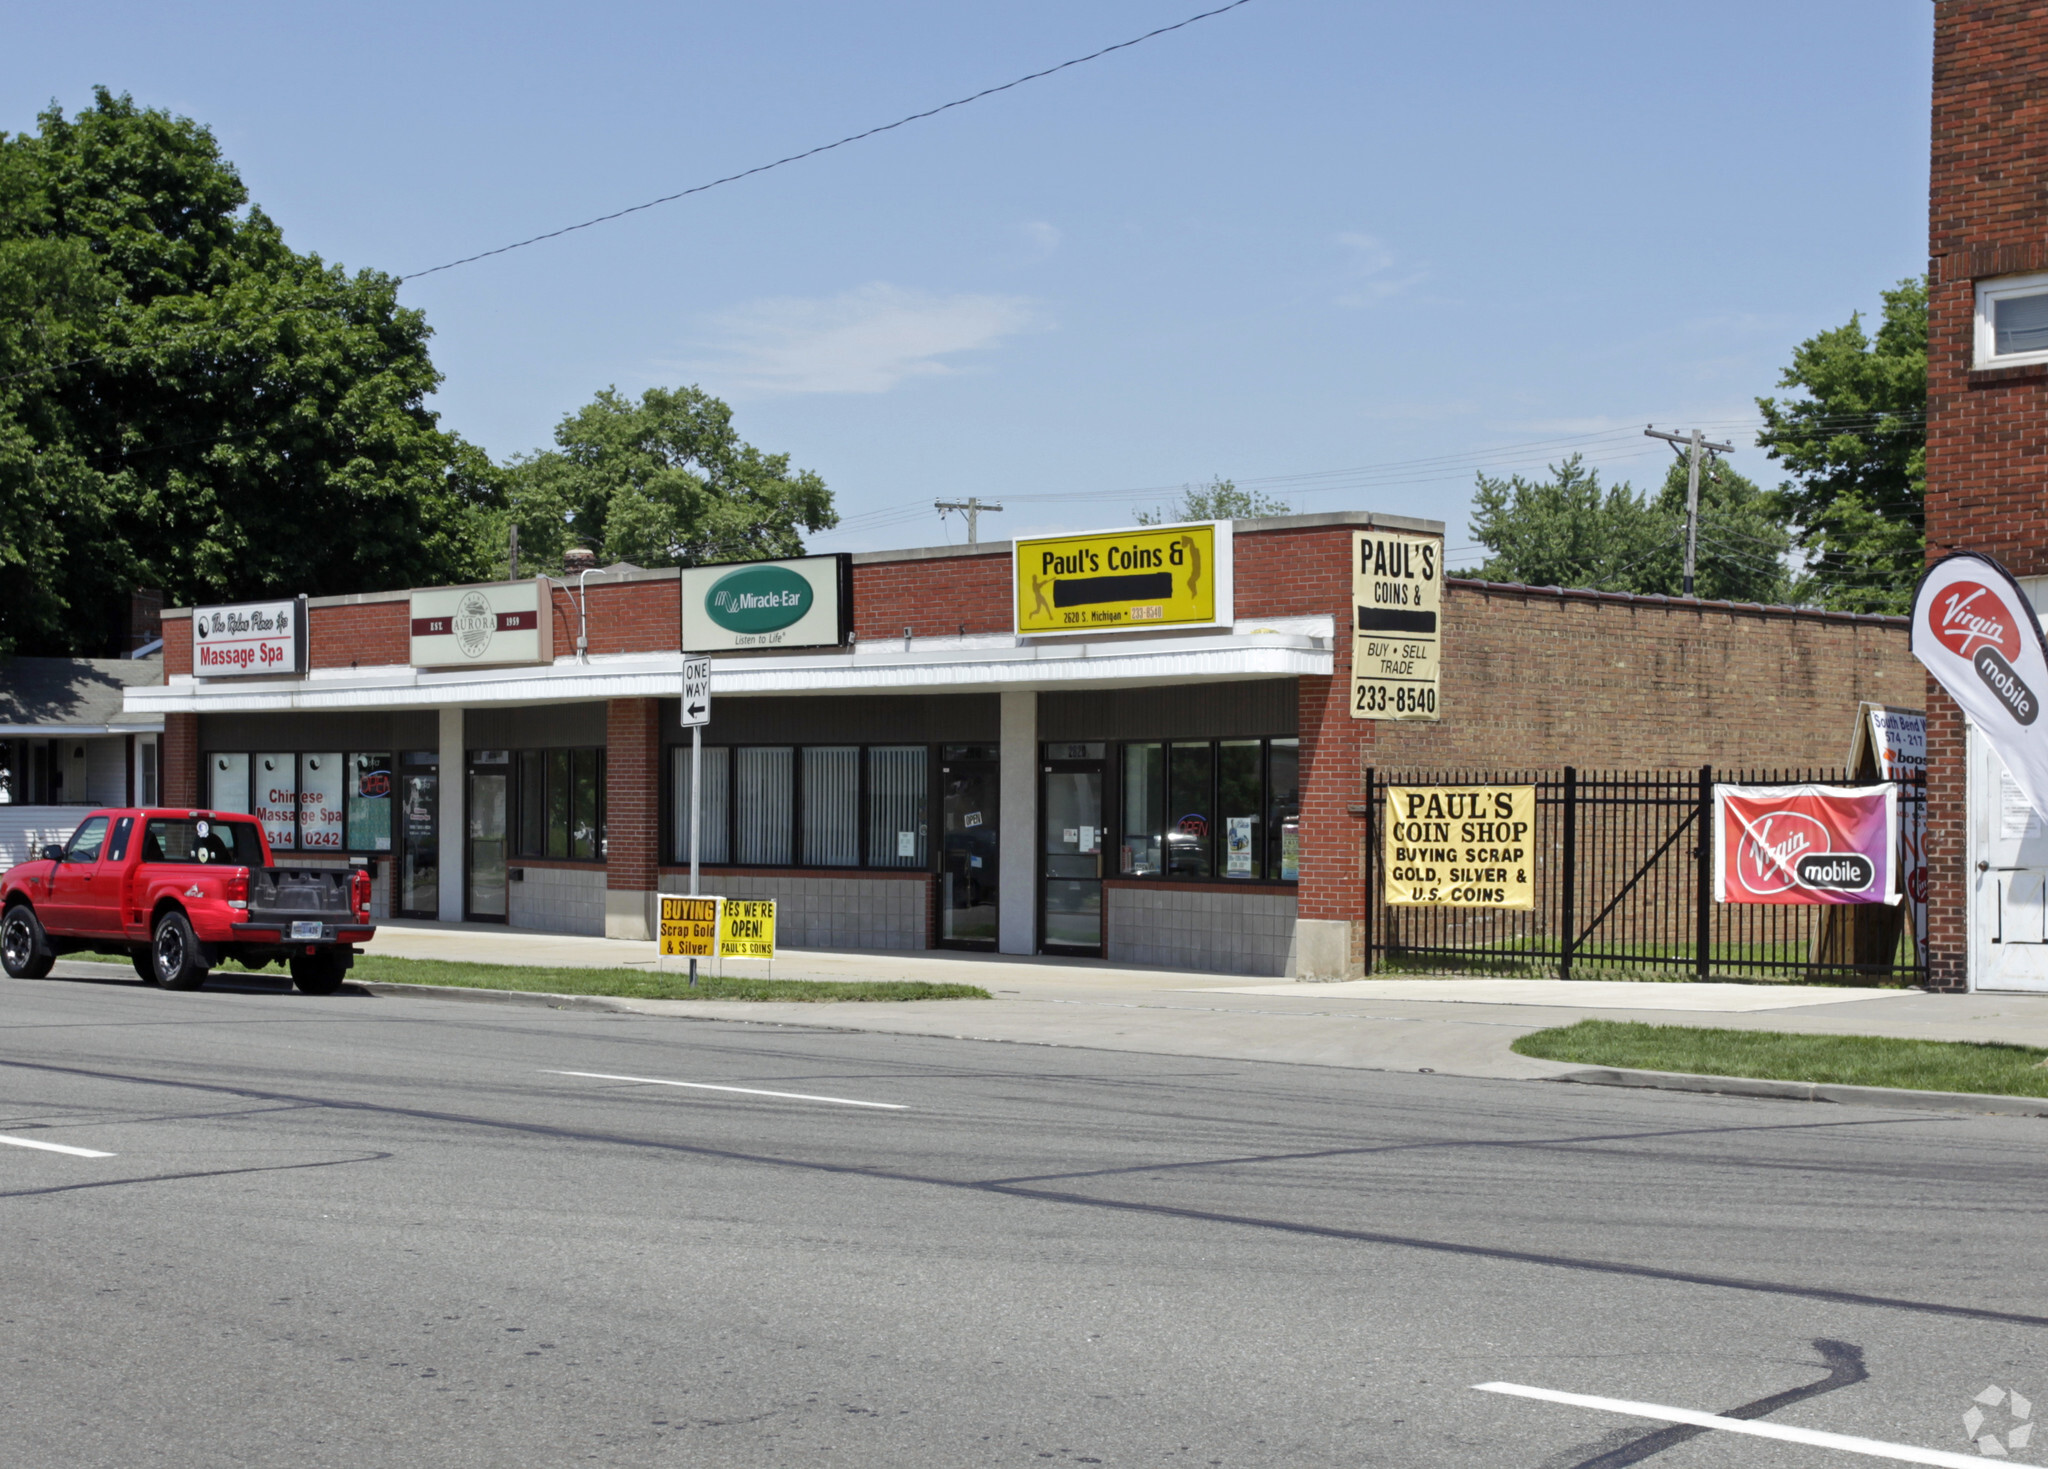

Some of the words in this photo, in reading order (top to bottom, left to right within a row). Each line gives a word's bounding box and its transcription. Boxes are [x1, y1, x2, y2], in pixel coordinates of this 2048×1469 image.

[1042, 549, 1099, 576] Paul's
[1108, 545, 1163, 571] Coins
[1169, 541, 1183, 565] &
[1361, 539, 1434, 581] PAUL'S
[740, 591, 801, 609] Miracle-Ear
[1374, 581, 1408, 605] COINS
[1414, 585, 1421, 606] &
[211, 612, 226, 634] The
[251, 610, 274, 631] Place
[453, 617, 496, 630] AURORA
[506, 617, 520, 626] 1959
[1091, 610, 1121, 624] Michigan
[1131, 606, 1162, 619] 233-8540
[1942, 588, 2004, 654] Virgin
[735, 634, 756, 645] Listen
[759, 635, 766, 644] to
[200, 646, 255, 668] Massage
[260, 642, 283, 667] Spa
[1367, 642, 1389, 657] BUY
[1402, 644, 1427, 659] SELL
[686, 663, 707, 680] ONE
[1380, 659, 1414, 674] TRADE
[685, 681, 708, 698] WAY
[1981, 658, 2030, 717] mobile
[1356, 685, 1435, 713] 233-8540
[1874, 714, 1898, 729] South
[1899, 716, 1920, 732] Bend
[1907, 734, 1923, 746] 217
[1897, 748, 1927, 765] boos
[1406, 792, 1513, 819] PAUL'S
[256, 807, 315, 826] Massage
[320, 808, 343, 825] Spa
[1180, 821, 1208, 836] OPEN
[1393, 822, 1451, 842] COIN
[1461, 822, 1528, 843] SHOP
[305, 832, 340, 845] 0242
[1396, 847, 1457, 863] BUYING
[1465, 848, 1524, 863] SCRAP
[1749, 818, 1810, 883] Virgin
[1392, 866, 1442, 885] GOLD,
[1449, 868, 1507, 882] SILVER
[1516, 868, 1527, 883] &
[1804, 861, 1861, 882] mobile
[1412, 887, 1442, 901] U.S.
[1451, 887, 1505, 902] COINS
[663, 900, 715, 920] BUYING
[723, 902, 740, 917] YES
[744, 902, 773, 918] WE'RE
[661, 923, 689, 938] Scrap
[693, 924, 715, 937] Gold
[731, 919, 763, 938] OPEN!
[667, 940, 674, 954] &
[678, 941, 708, 954] Silver
[721, 942, 747, 953] PAUL'S
[750, 943, 772, 953] COINS
